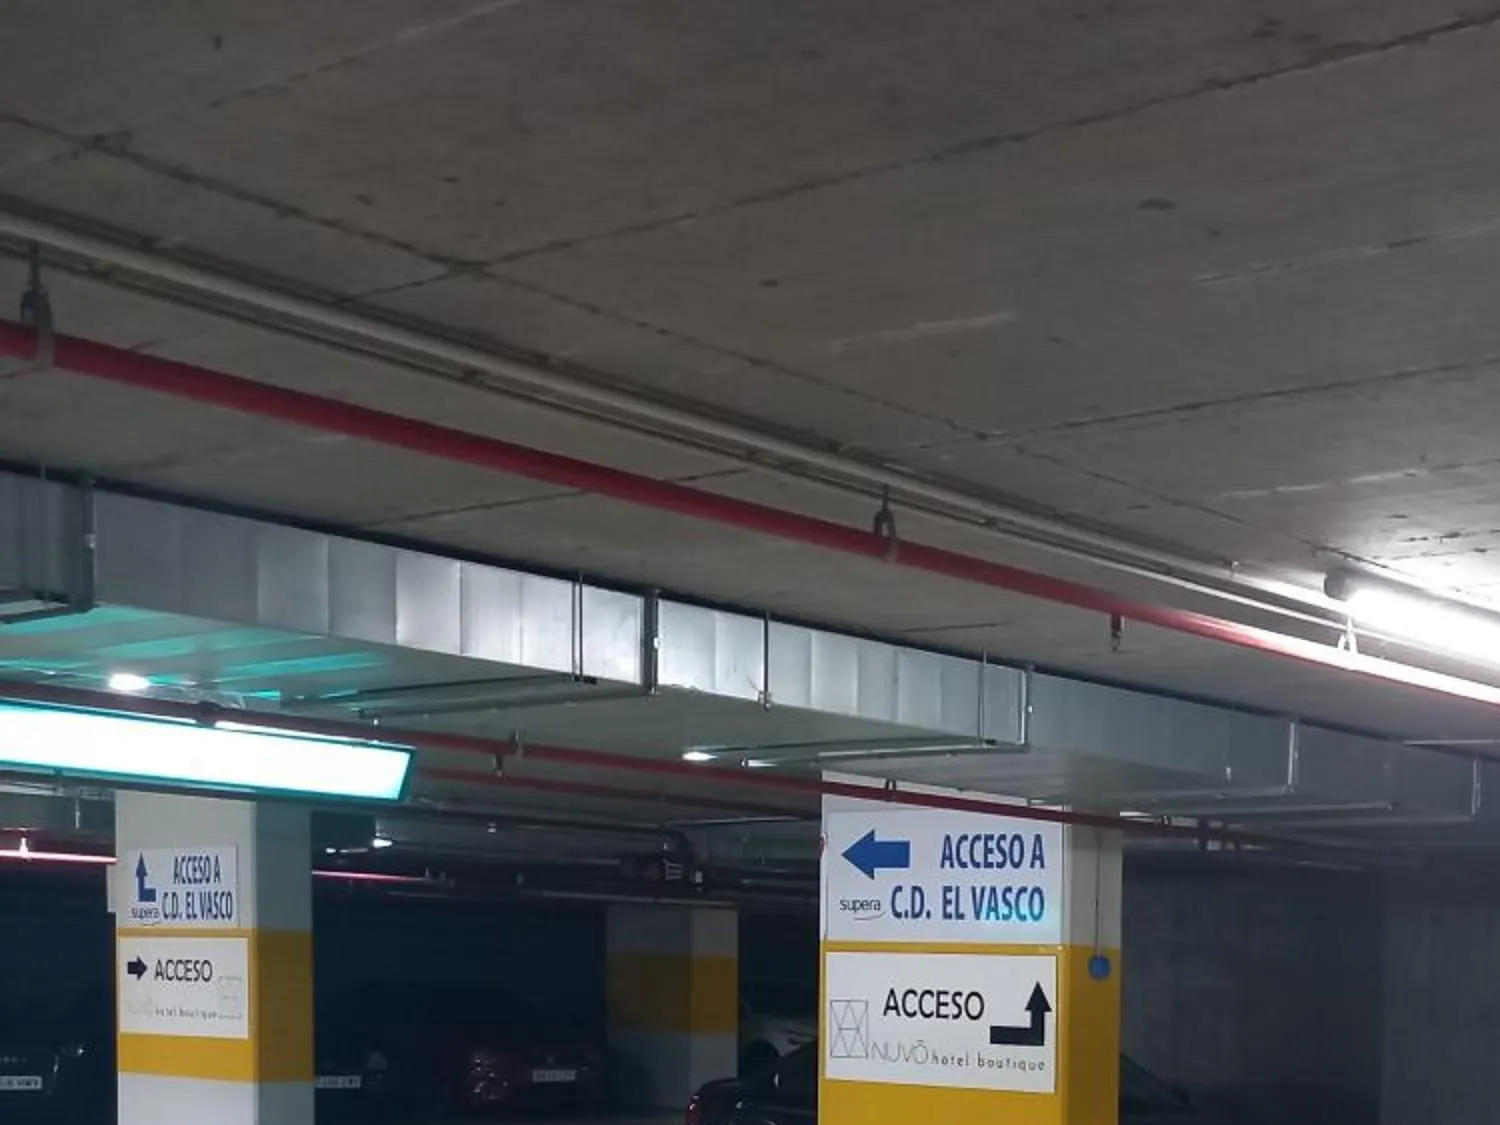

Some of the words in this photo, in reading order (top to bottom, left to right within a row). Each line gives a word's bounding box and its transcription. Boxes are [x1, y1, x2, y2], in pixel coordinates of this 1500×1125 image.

[940, 834, 1025, 869] ACCESO
[1030, 834, 1045, 869] A
[173, 855, 211, 884] ACCESO
[213, 854, 221, 884] A
[185, 891, 197, 919] EL
[199, 891, 233, 920] VASCO
[839, 899, 881, 913] supera
[891, 885, 931, 919] C.D.
[942, 886, 965, 920] EL
[971, 886, 1045, 921] VASCO
[154, 959, 213, 982] ACCESO
[883, 988, 985, 1020] ACCESO
[932, 1053, 970, 1068] hotel
[977, 1053, 1047, 1073] boutique
